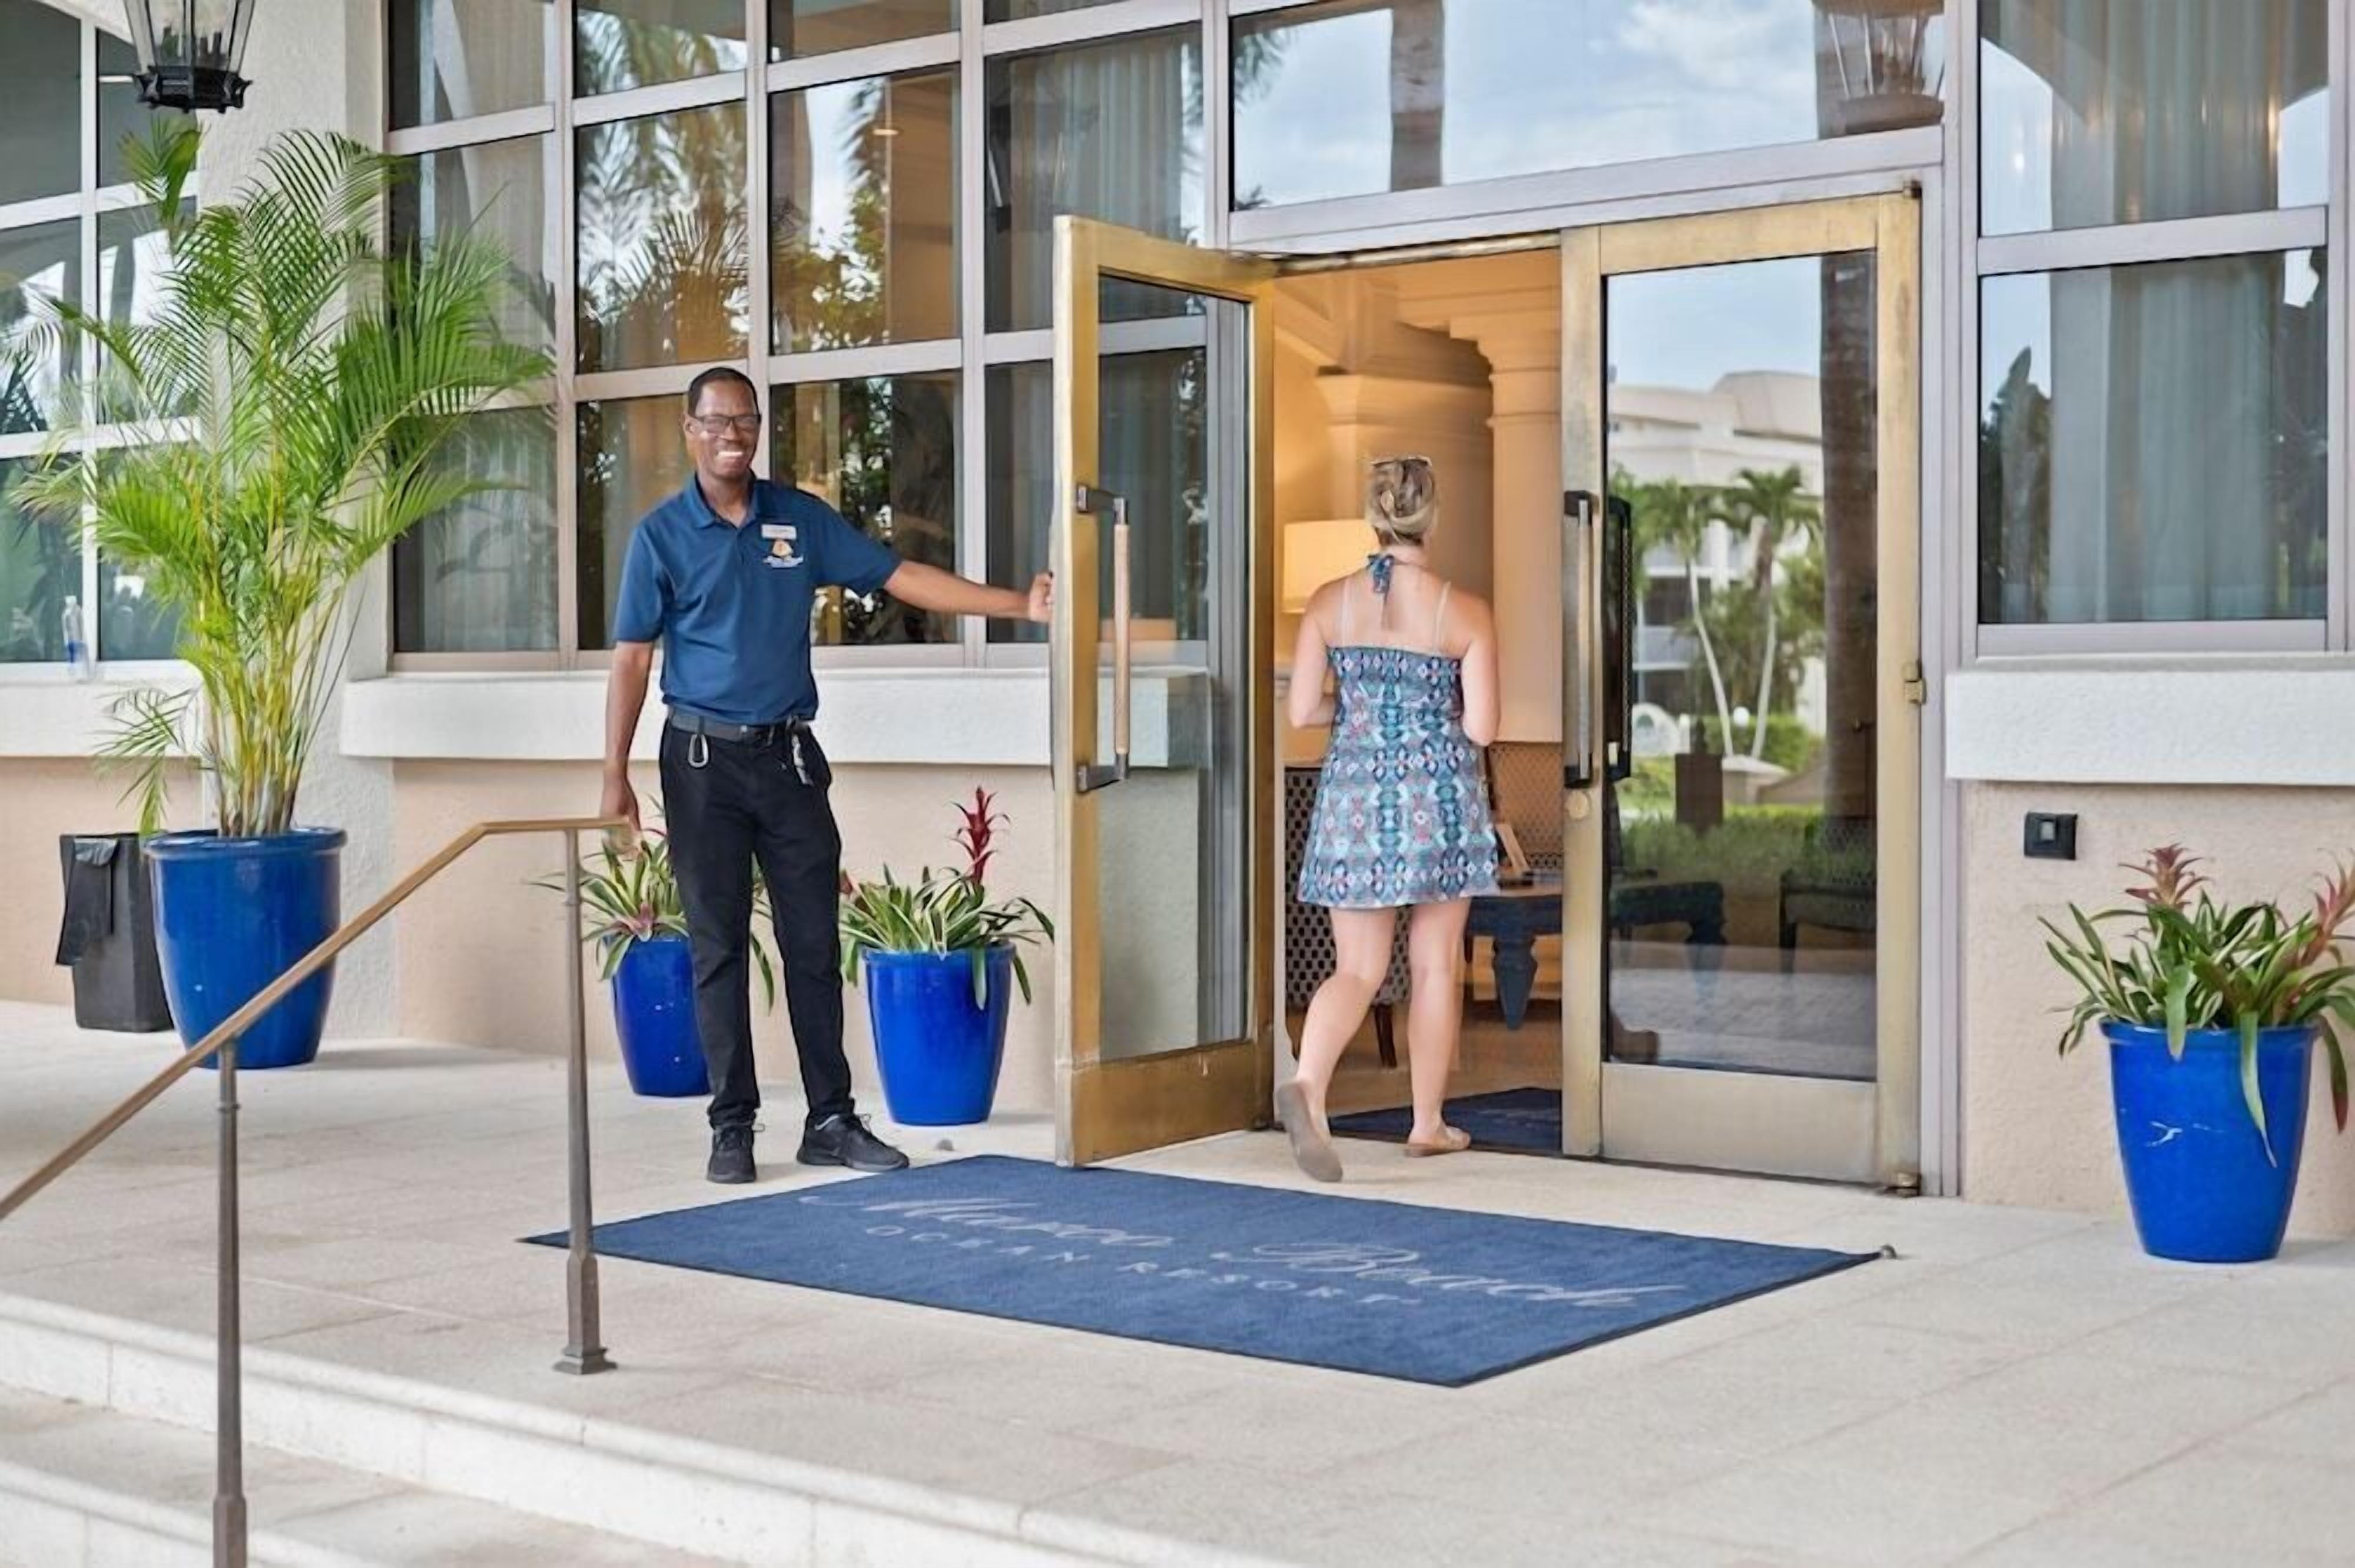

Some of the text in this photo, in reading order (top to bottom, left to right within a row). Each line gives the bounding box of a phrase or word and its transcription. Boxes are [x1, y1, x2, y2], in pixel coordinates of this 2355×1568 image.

[798, 1196, 1687, 1308] Marco Beach
[865, 1225, 1423, 1305] OCEAN RESORT
